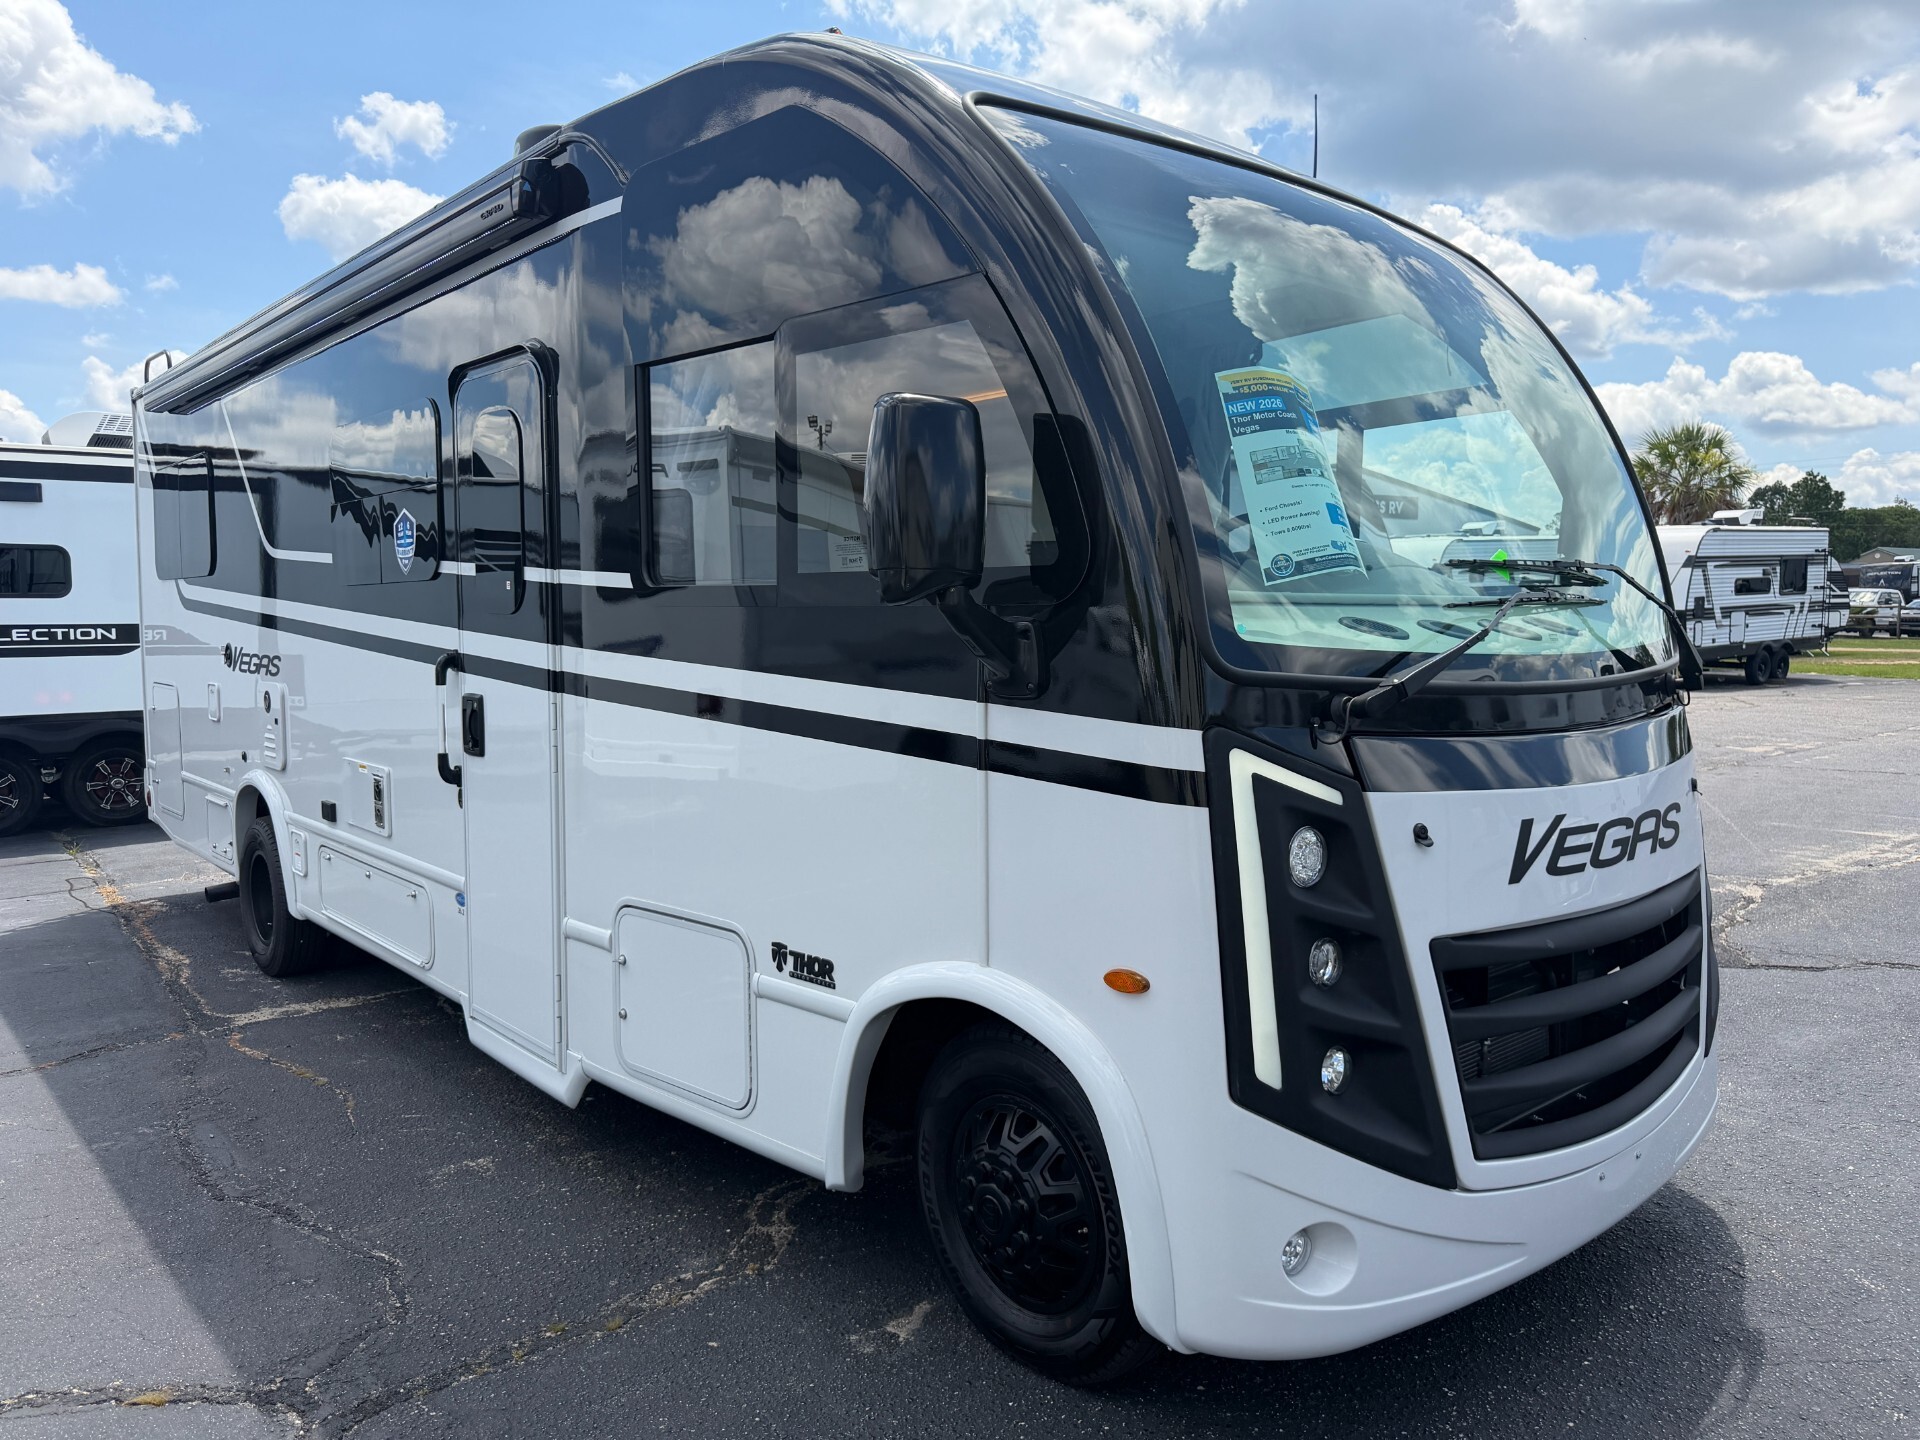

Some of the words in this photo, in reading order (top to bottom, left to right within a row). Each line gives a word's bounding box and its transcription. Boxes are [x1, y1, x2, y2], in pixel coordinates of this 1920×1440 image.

[1228, 401, 1255, 414] NEW
[1259, 399, 1283, 409] 2026
[1231, 415, 1251, 424] Thor
[1253, 411, 1276, 421] Motor
[1233, 424, 1260, 434] Vegas
[1264, 504, 1279, 512] Ford
[1389, 500, 1404, 515] RV
[1267, 517, 1280, 525] LED
[1280, 513, 1298, 521] Power
[1270, 529, 1286, 537] Tows
[1508, 802, 1682, 885] VEGAS
[788, 949, 836, 983] THOR
[813, 978, 835, 989] COACH
